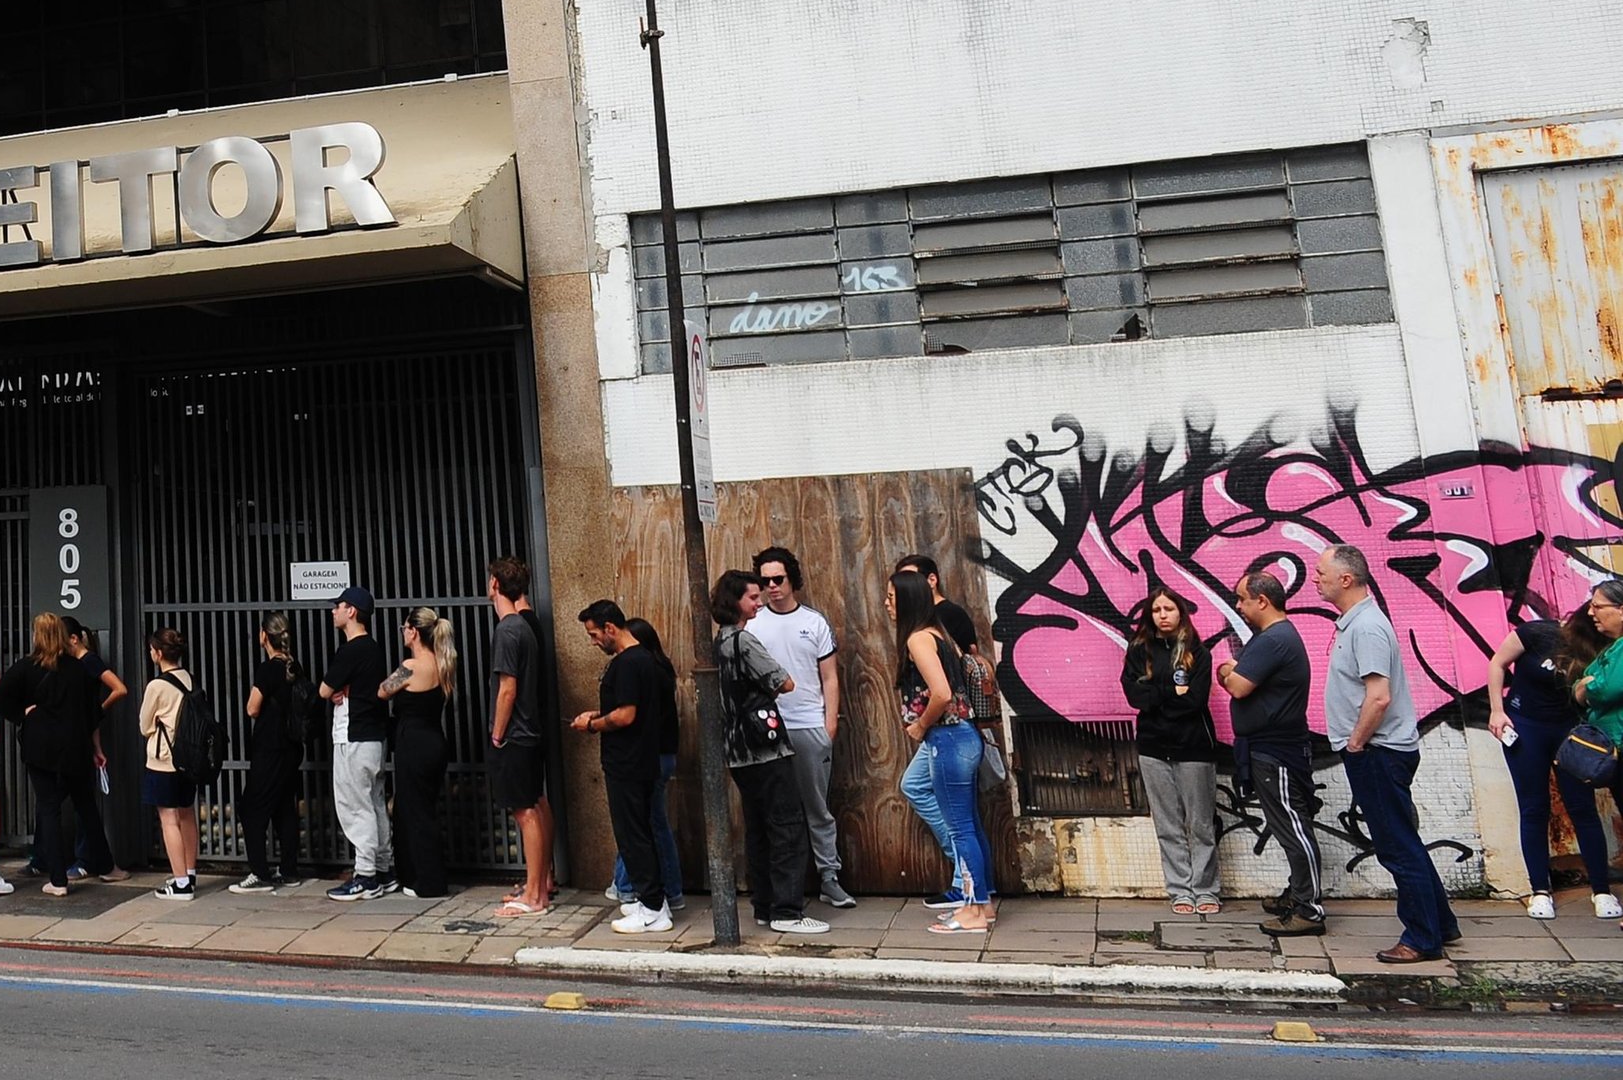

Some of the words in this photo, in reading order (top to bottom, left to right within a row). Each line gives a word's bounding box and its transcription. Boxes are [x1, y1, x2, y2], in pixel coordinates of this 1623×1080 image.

[58, 508, 81, 610] 805
[302, 570, 338, 578] GARAGEM
[293, 581, 309, 590] NÃO
[310, 582, 347, 590] ESTACIONE
